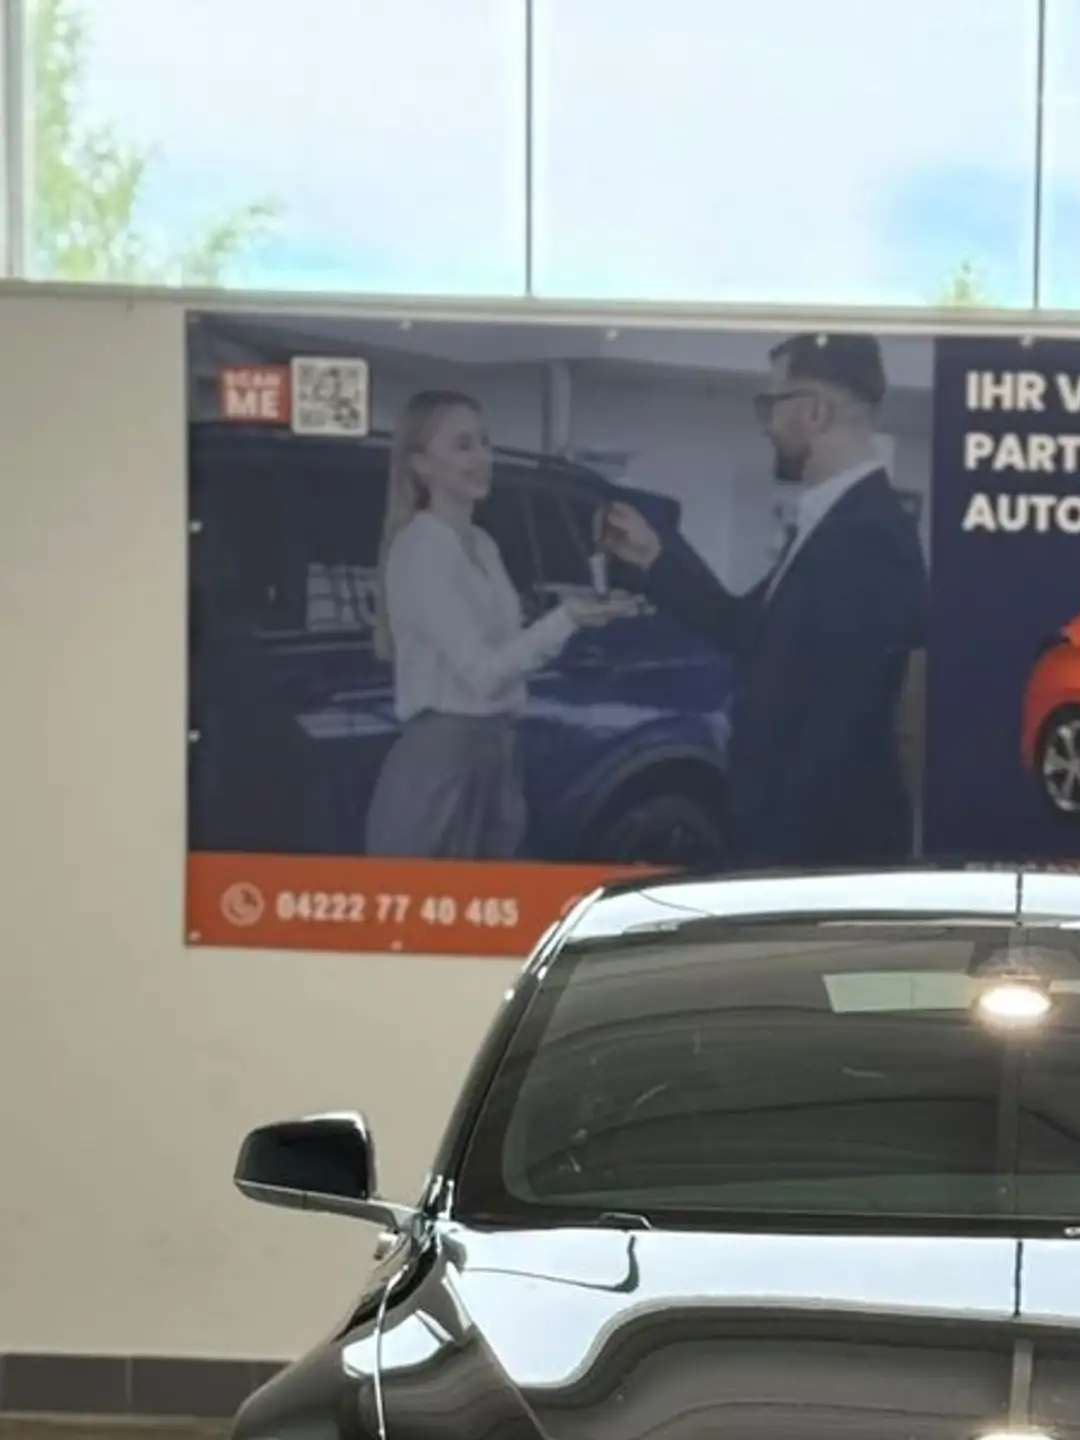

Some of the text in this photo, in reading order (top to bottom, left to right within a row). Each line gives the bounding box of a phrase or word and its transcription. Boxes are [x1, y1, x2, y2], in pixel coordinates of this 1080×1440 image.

[226, 388, 280, 419] ME
[966, 371, 1046, 414] IHR
[276, 891, 365, 922] 04222
[376, 892, 410, 924] 77
